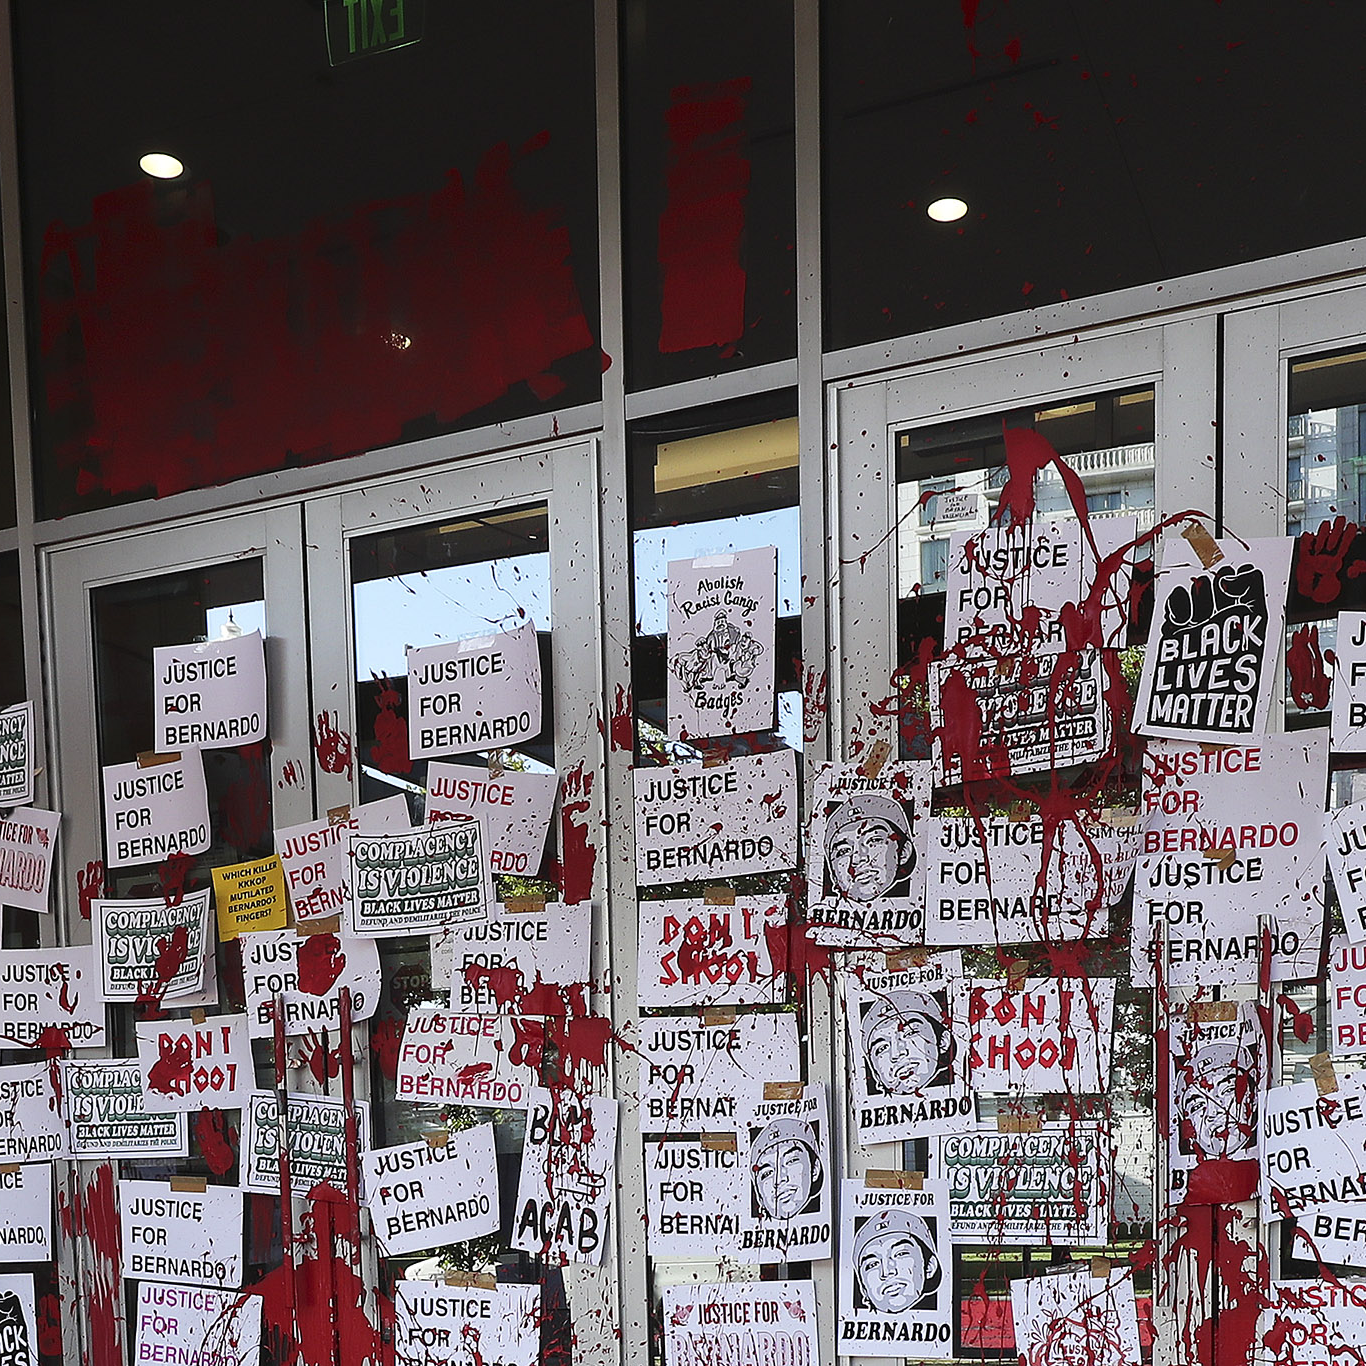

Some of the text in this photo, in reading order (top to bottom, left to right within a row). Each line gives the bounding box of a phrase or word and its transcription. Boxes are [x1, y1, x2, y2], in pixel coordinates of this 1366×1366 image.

[697, 575, 744, 594] Abolish
[1160, 615, 1264, 663] BLACK
[1156, 654, 1257, 692] LIVES
[420, 694, 461, 716] FOR
[695, 693, 744, 719] Badges
[1150, 693, 1254, 729] MATTER
[115, 808, 152, 831] FOR
[645, 813, 691, 836] FOR
[355, 829, 476, 862] COMPLACENCY
[222, 861, 277, 881] WHICH KILLER
[290, 863, 327, 889] FOR
[359, 855, 479, 892] IS VIOLENCE
[229, 885, 275, 902] MUTILATED
[364, 892, 479, 915] BLACK LIVES MATTER
[235, 908, 272, 923] FINGERS?
[393, 974, 428, 989] STOP
[130, 1198, 203, 1221] JUSTICE
[861, 1192, 935, 1206] JUSTICE FOR
[132, 1228, 167, 1246] FOR
[518, 1199, 599, 1254] ACAB
[409, 1298, 491, 1319] JUSTICE
[754, 1301, 780, 1323] FOR
[842, 1320, 951, 1344] BERNARDO
